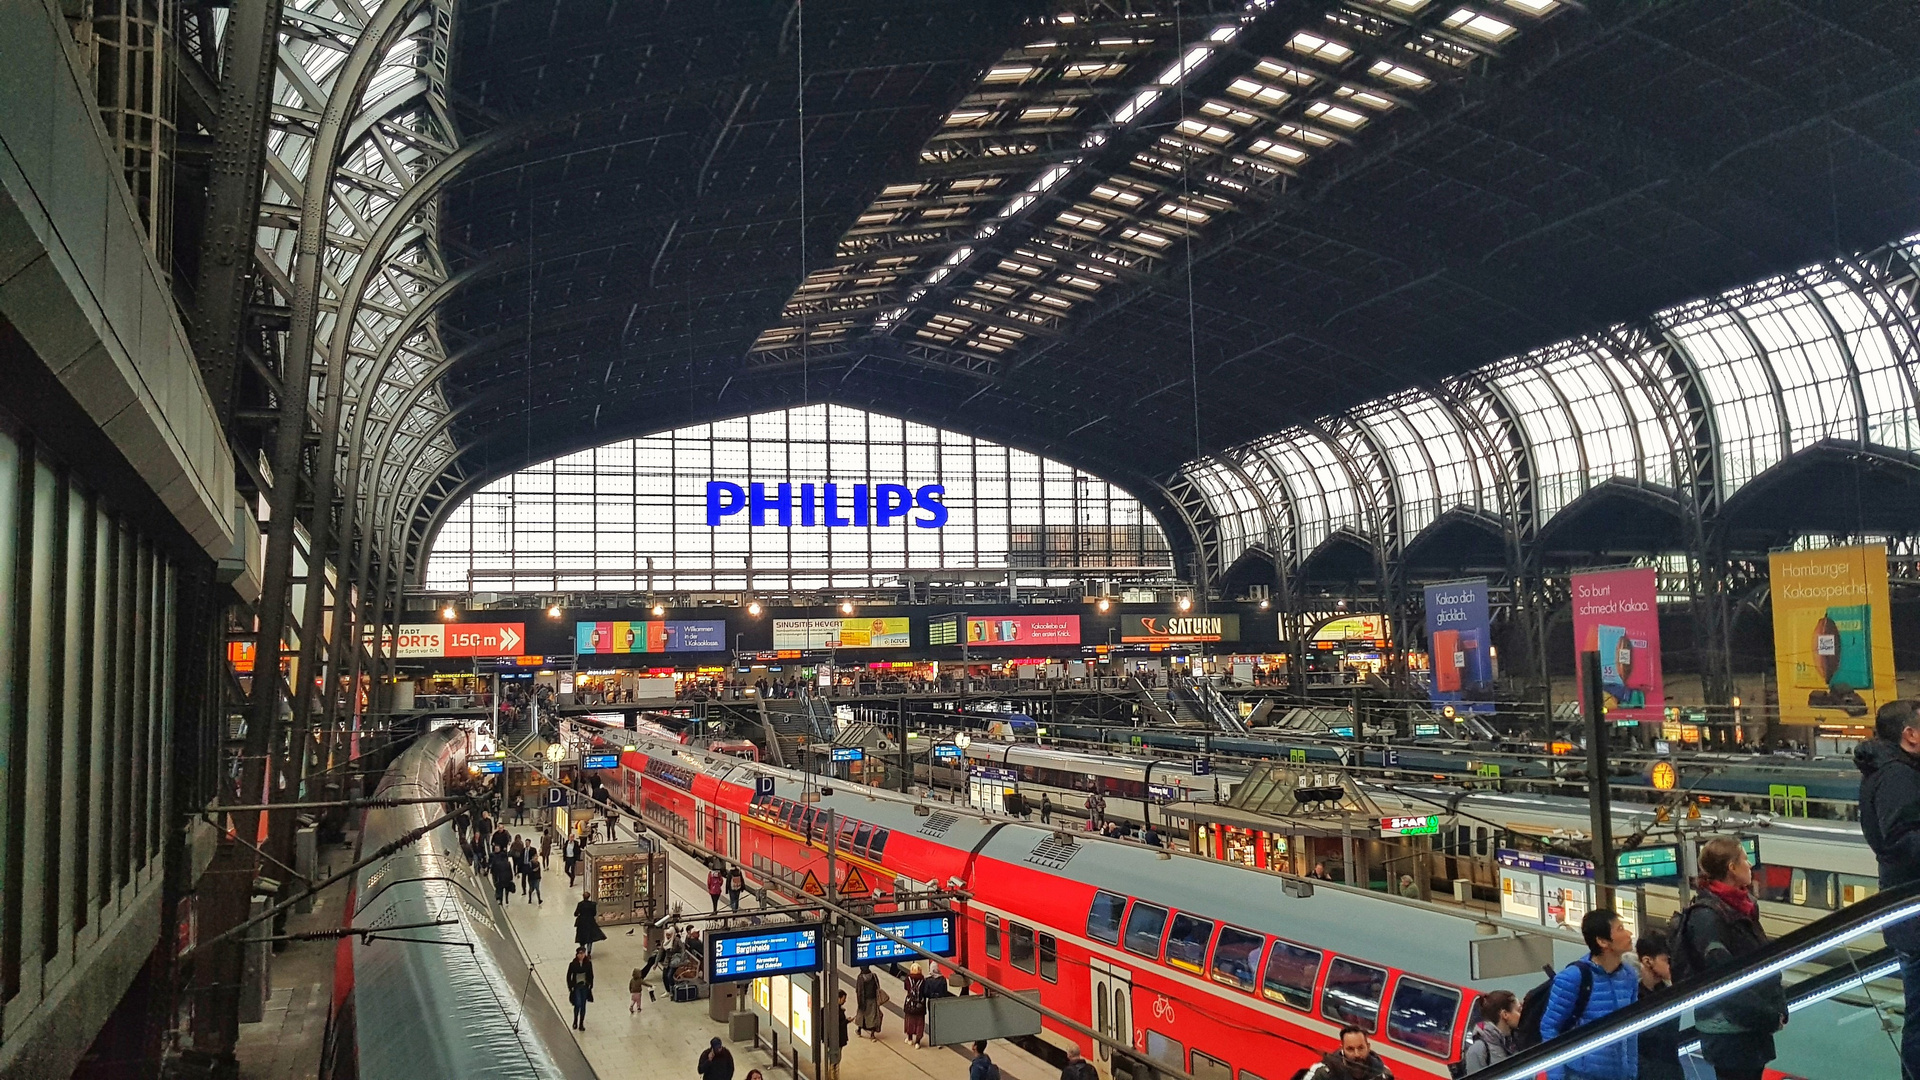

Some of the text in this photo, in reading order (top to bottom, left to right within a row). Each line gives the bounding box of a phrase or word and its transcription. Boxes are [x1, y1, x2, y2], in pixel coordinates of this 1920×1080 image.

[706, 480, 948, 528] PHILIPS
[1782, 560, 1850, 578] Hamburger
[1578, 584, 1610, 598] So bunt
[1783, 578, 1874, 600] Kakaospeicher.
[1436, 590, 1475, 605] Kakao dich
[1580, 598, 1650, 615] schmeckt Kakao.
[1436, 608, 1468, 626] glücklich.
[1168, 618, 1222, 634] SATURN
[451, 634, 496, 646] 150 m
[1390, 750, 1398, 764] E
[1196, 760, 1204, 773] E
[762, 778, 773, 792] D
[550, 788, 562, 804] D
[1391, 816, 1426, 828] SPAR
[942, 918, 949, 930] 6
[716, 940, 723, 953] 5
